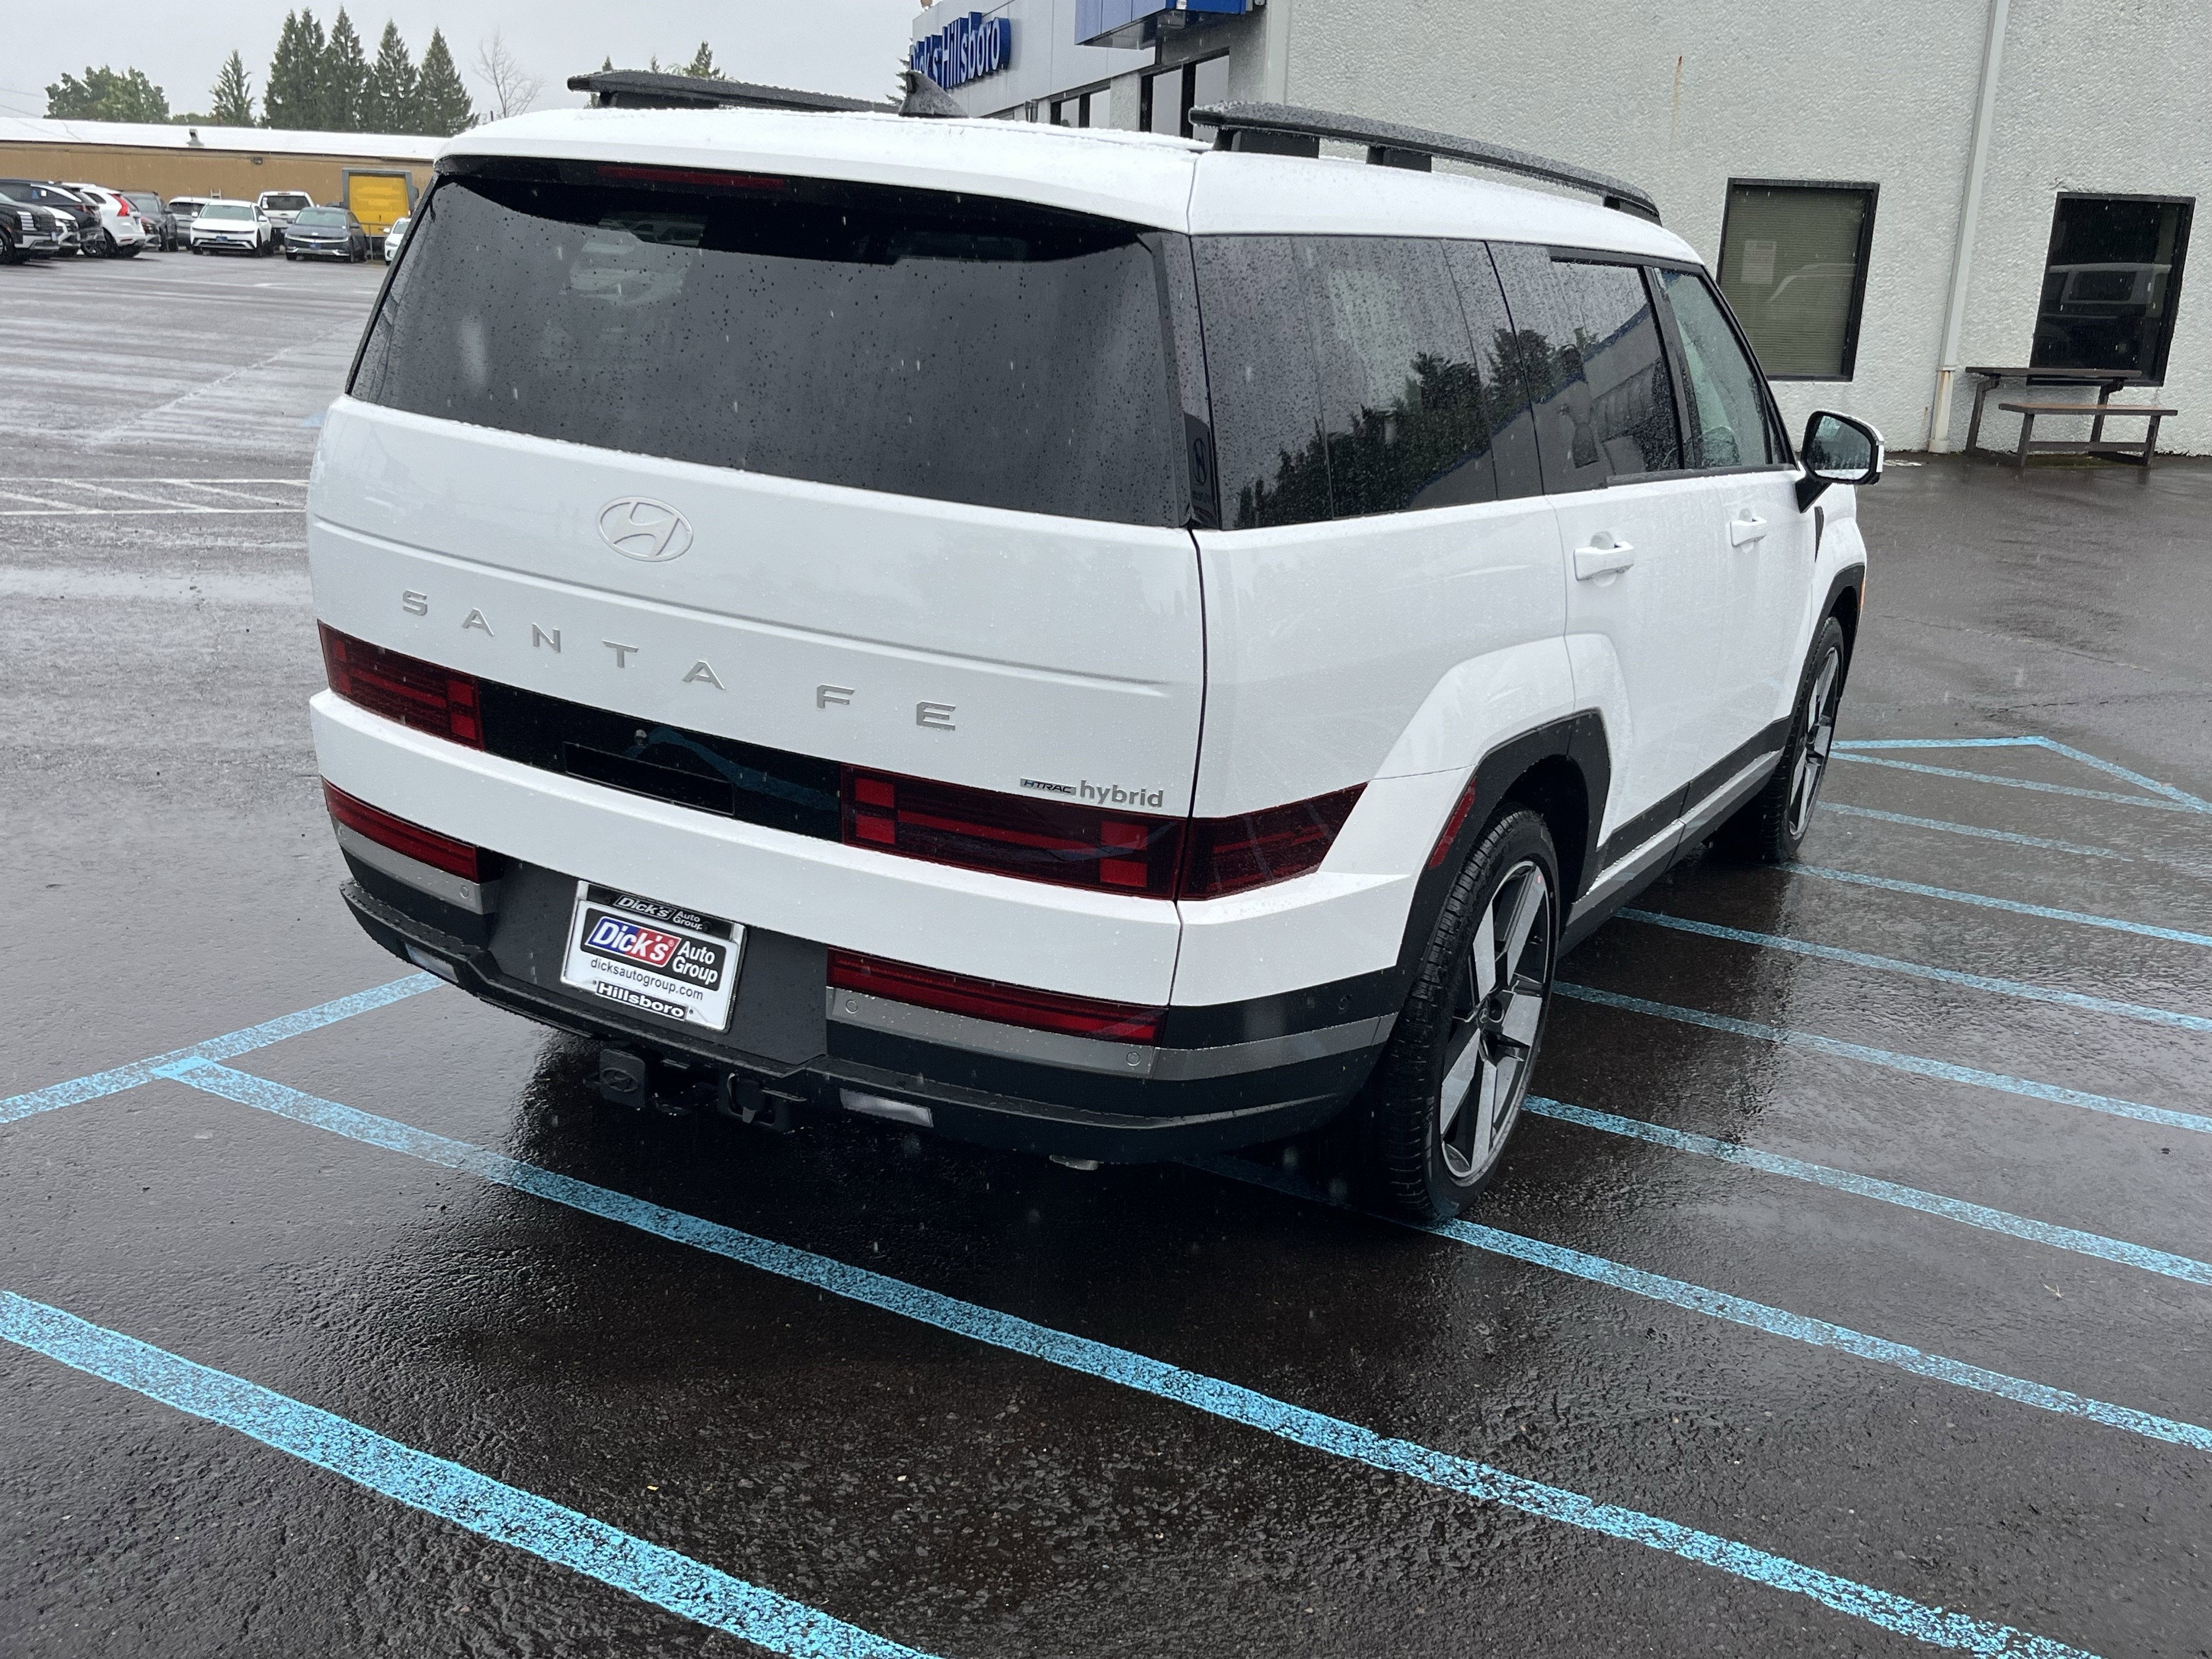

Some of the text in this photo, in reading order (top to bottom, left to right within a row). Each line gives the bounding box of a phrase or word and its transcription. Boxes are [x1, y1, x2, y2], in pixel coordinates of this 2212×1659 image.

[942, 12, 1001, 89] Hillsboro
[402, 589, 956, 731] SANTA FE
[1024, 779, 1164, 808] HTRAC hybrid
[618, 897, 669, 918] Dick's
[675, 911, 701, 923] Auto
[592, 921, 669, 962] Dick's
[678, 940, 715, 965] Auto
[590, 957, 703, 1001] dicksautogroup.com
[672, 956, 719, 985] Group
[598, 982, 685, 1017] Hillsboro
